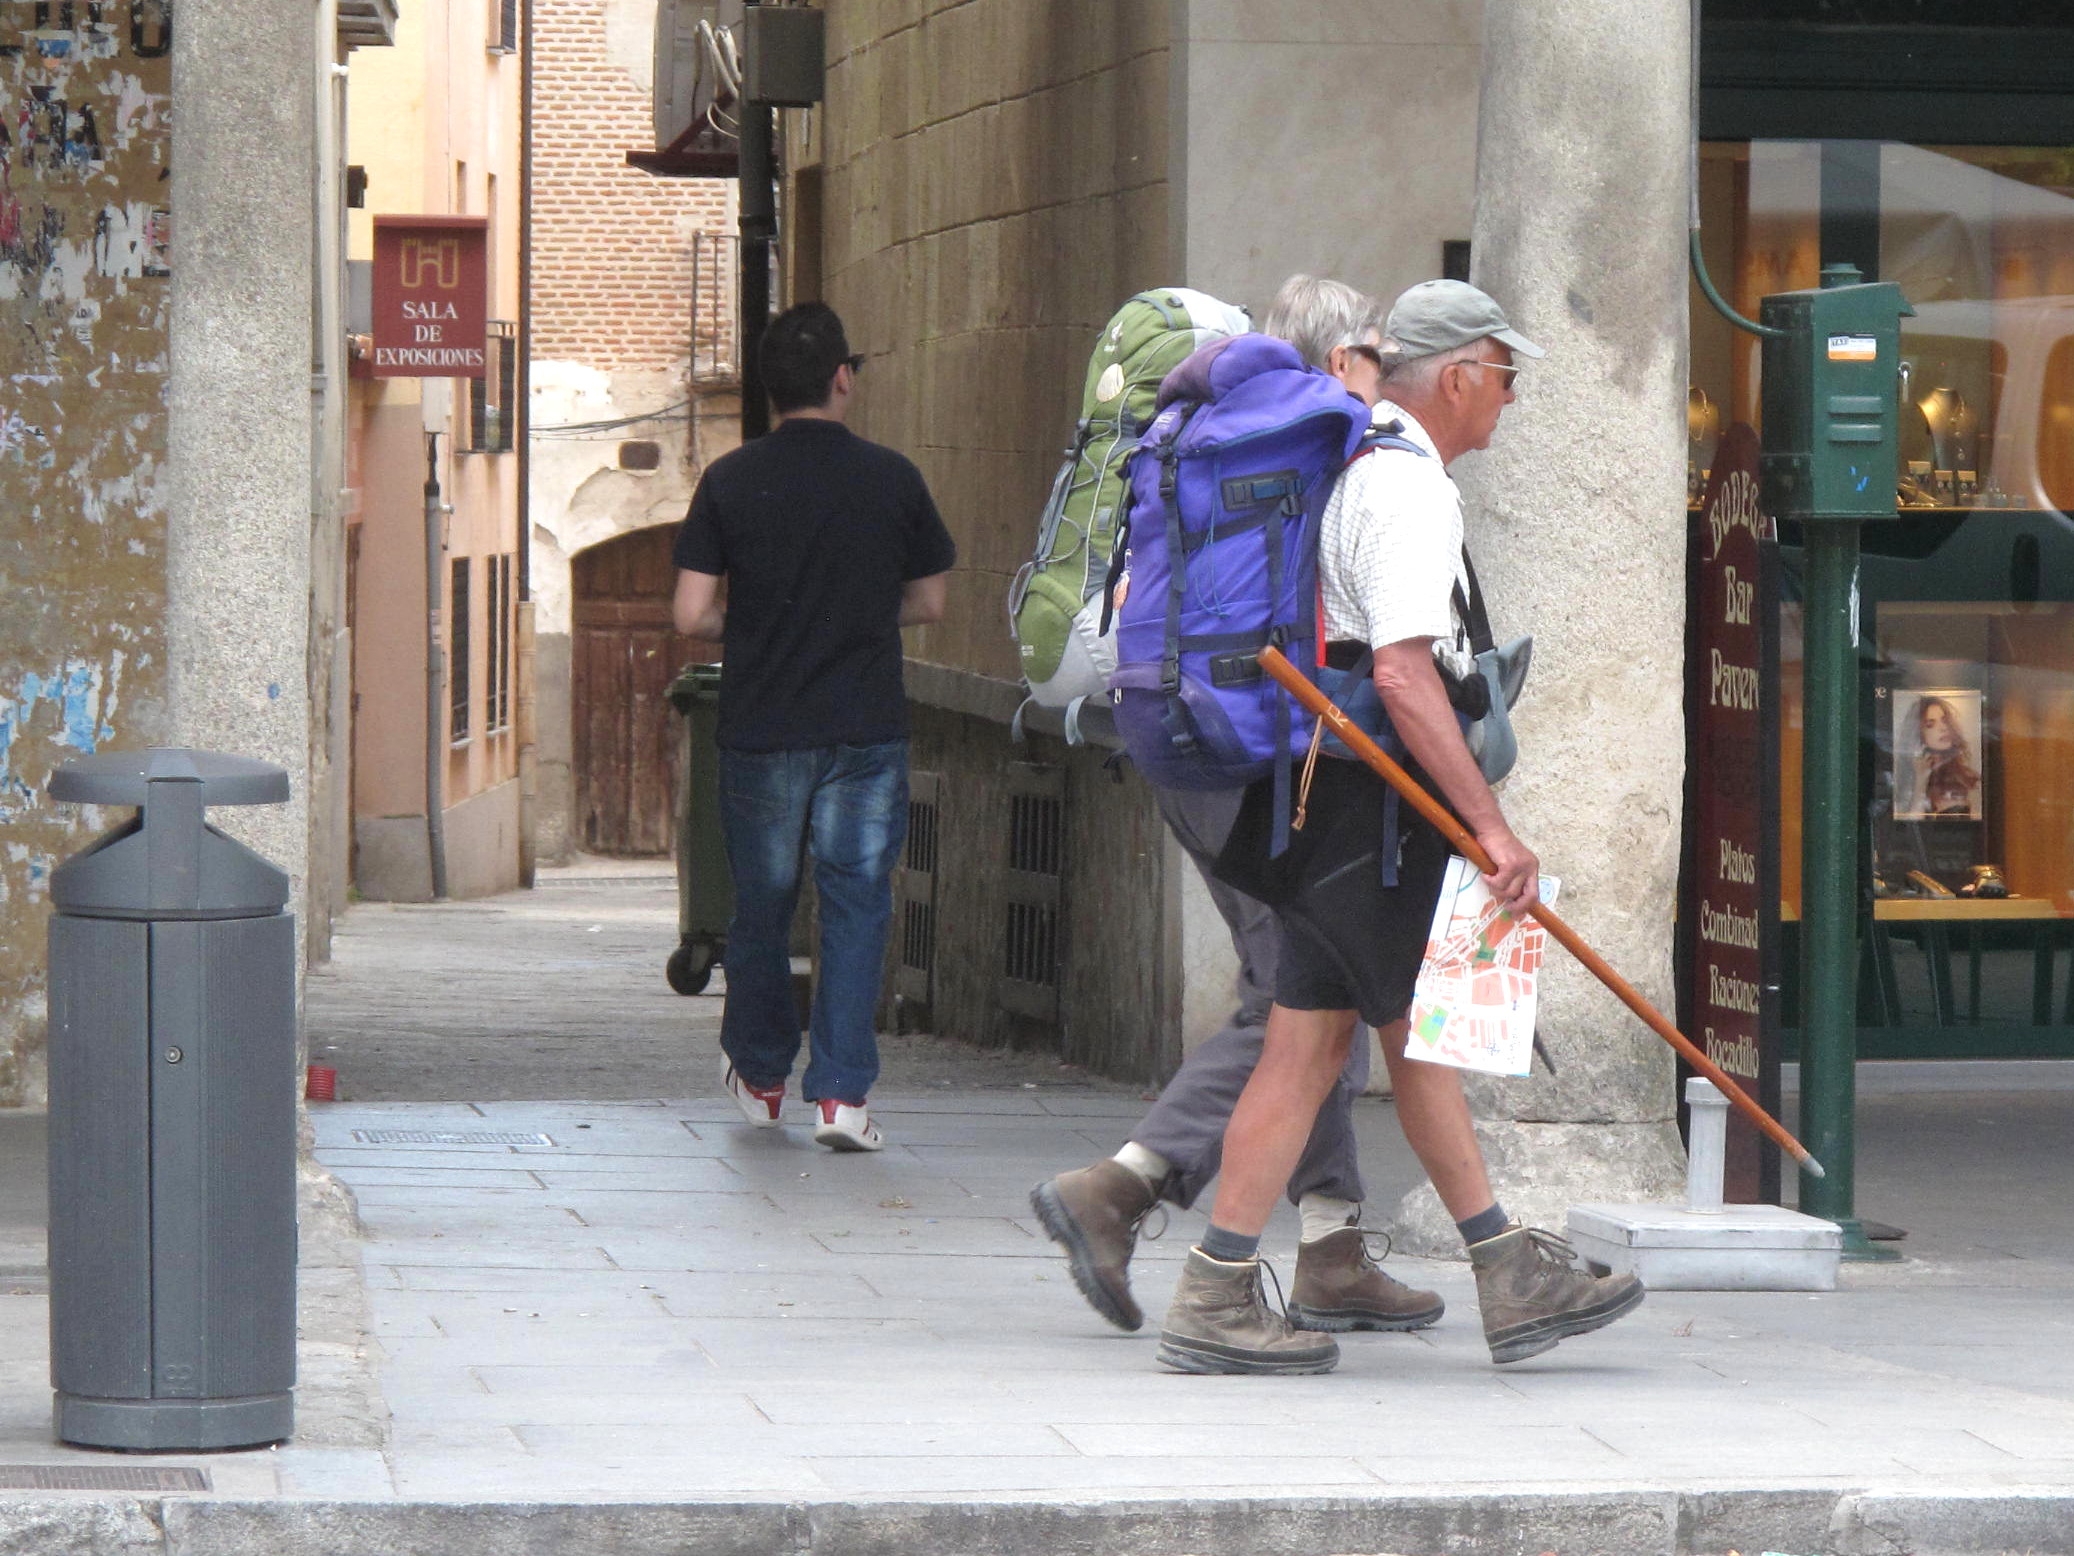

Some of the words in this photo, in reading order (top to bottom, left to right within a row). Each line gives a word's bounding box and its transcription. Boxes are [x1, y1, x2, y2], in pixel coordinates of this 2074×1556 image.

[402, 301, 458, 319] SALA
[415, 325, 442, 342] DE
[375, 348, 483, 366] EXPOSICIONES
[1725, 565, 1753, 624] Bar
[1720, 838, 1755, 884] Platos
